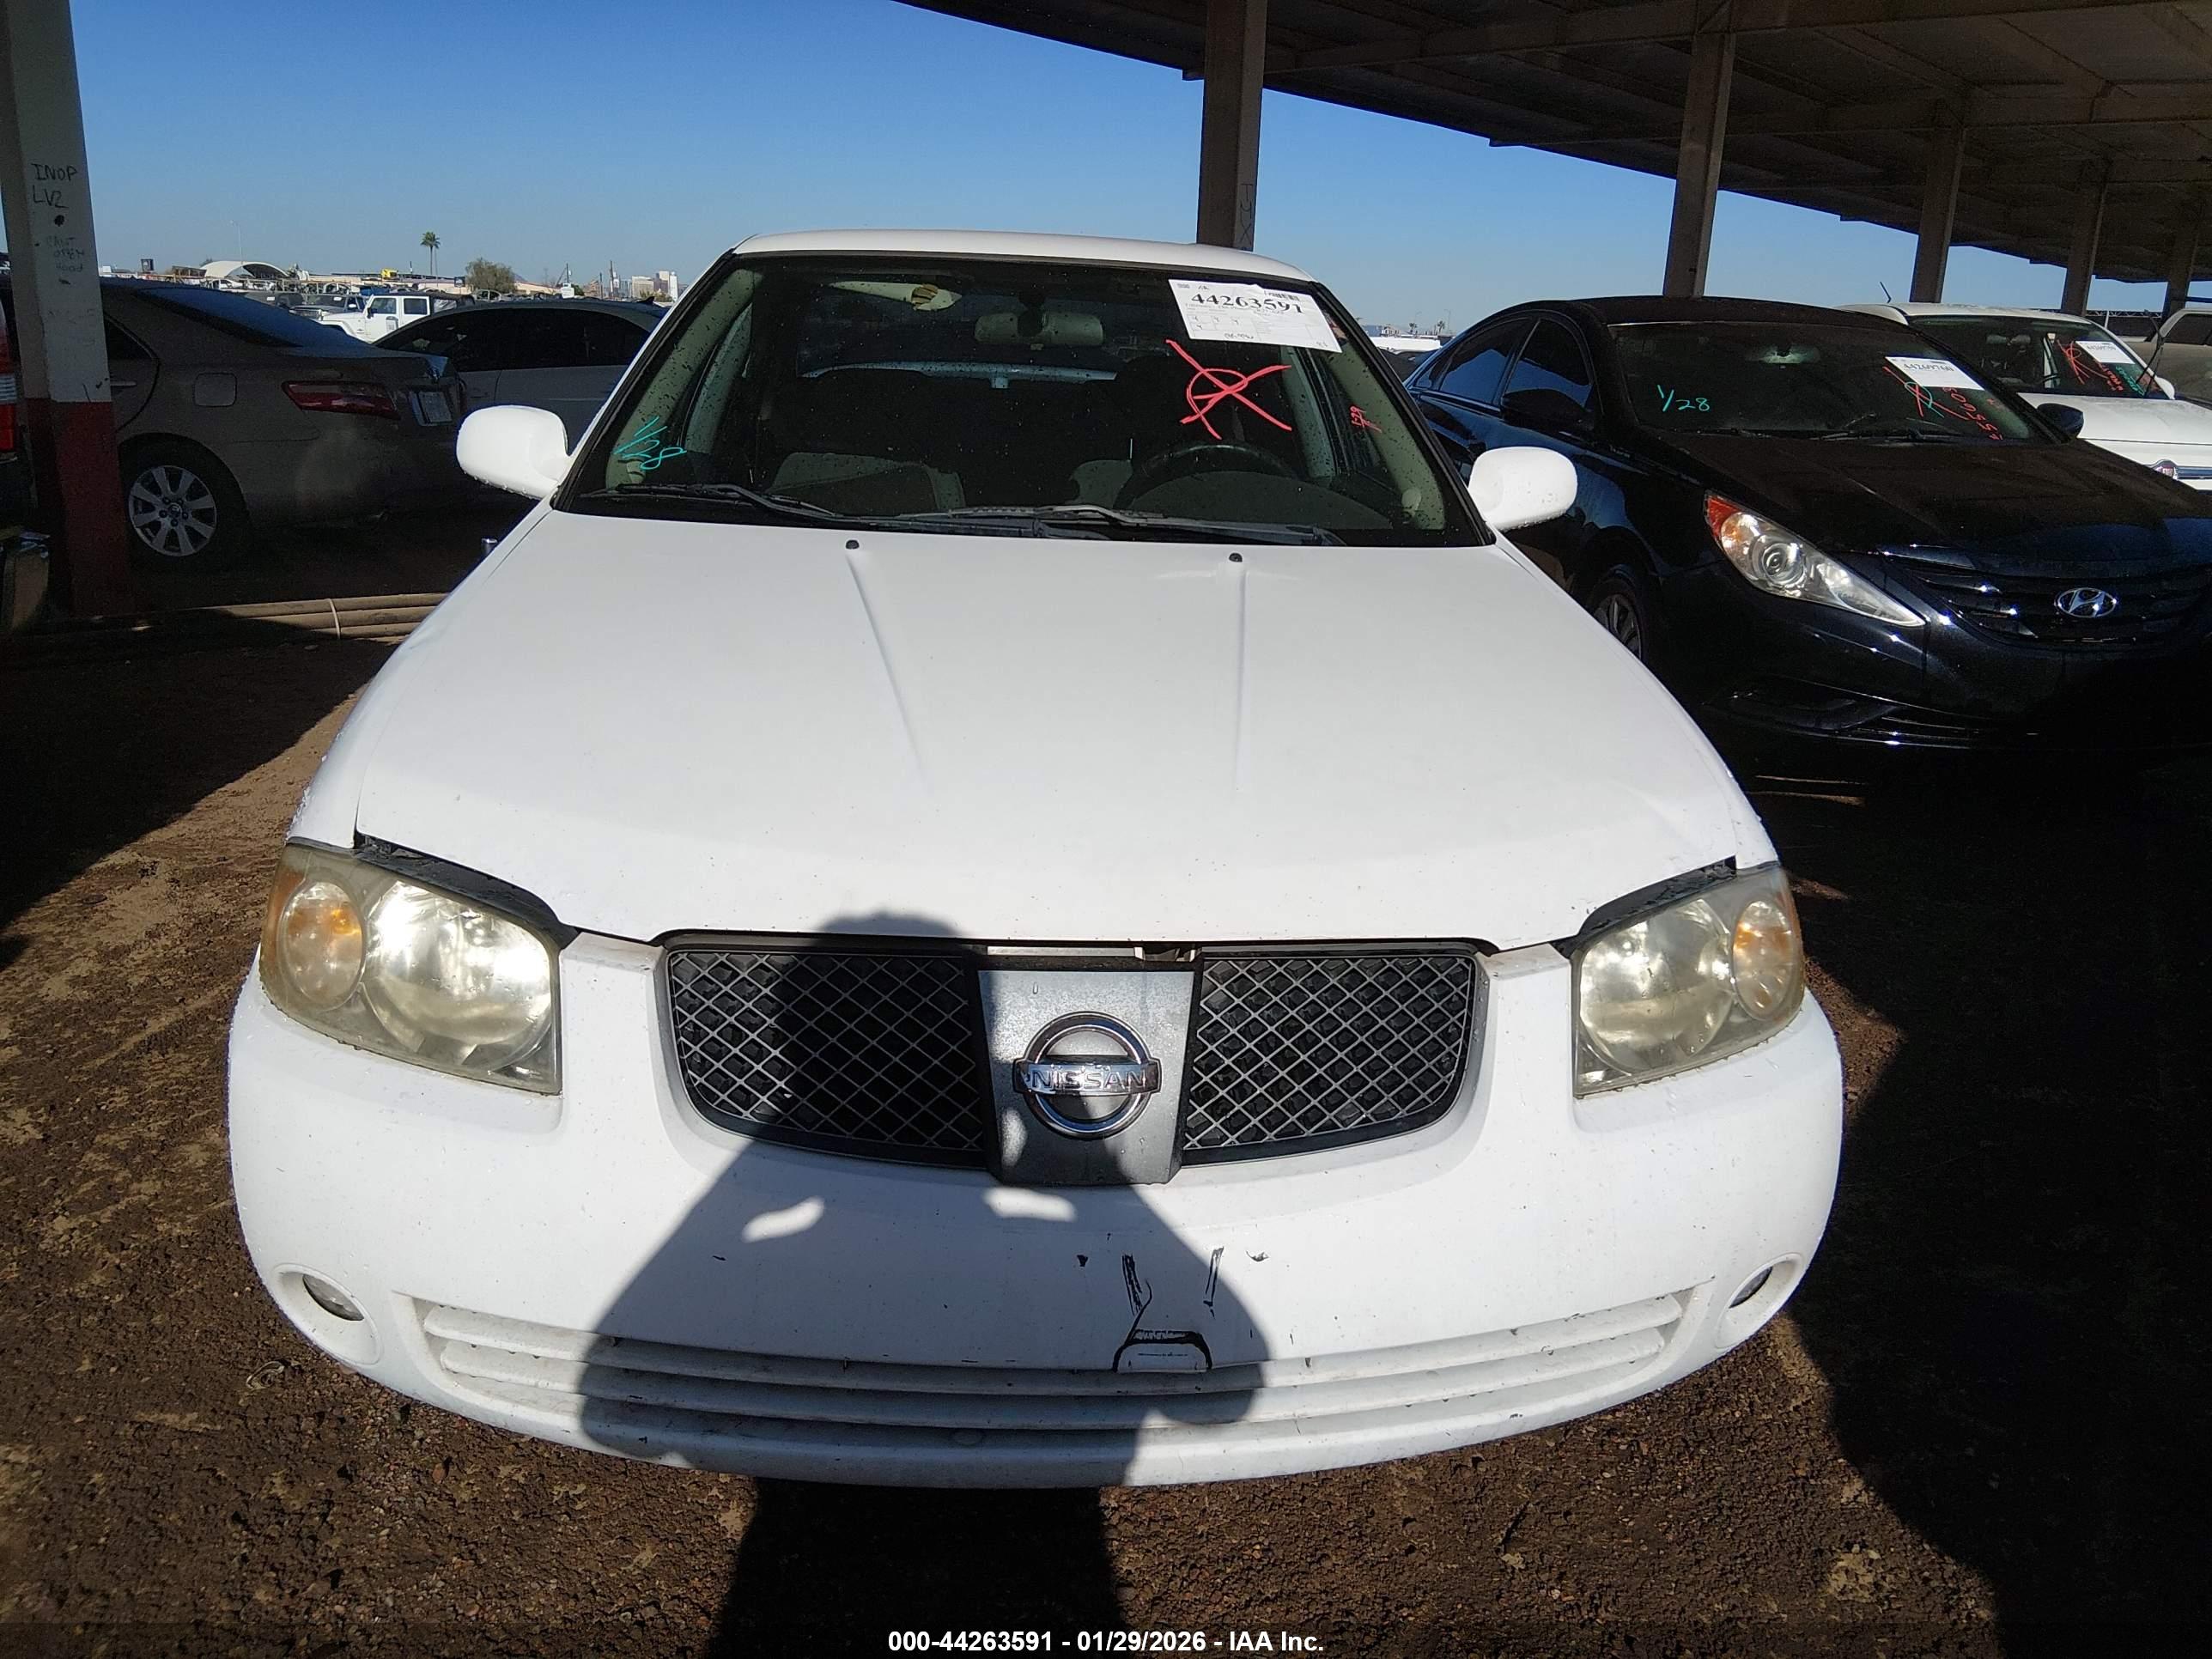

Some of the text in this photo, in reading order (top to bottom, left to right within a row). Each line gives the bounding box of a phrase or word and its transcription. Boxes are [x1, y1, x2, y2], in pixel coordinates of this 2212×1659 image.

[31, 163, 78, 181] INOP
[33, 185, 69, 208] LV2
[1191, 293, 1304, 314] 44263591
[1656, 384, 1711, 412] 1/28
[1031, 1069, 1146, 1089] NISSAN
